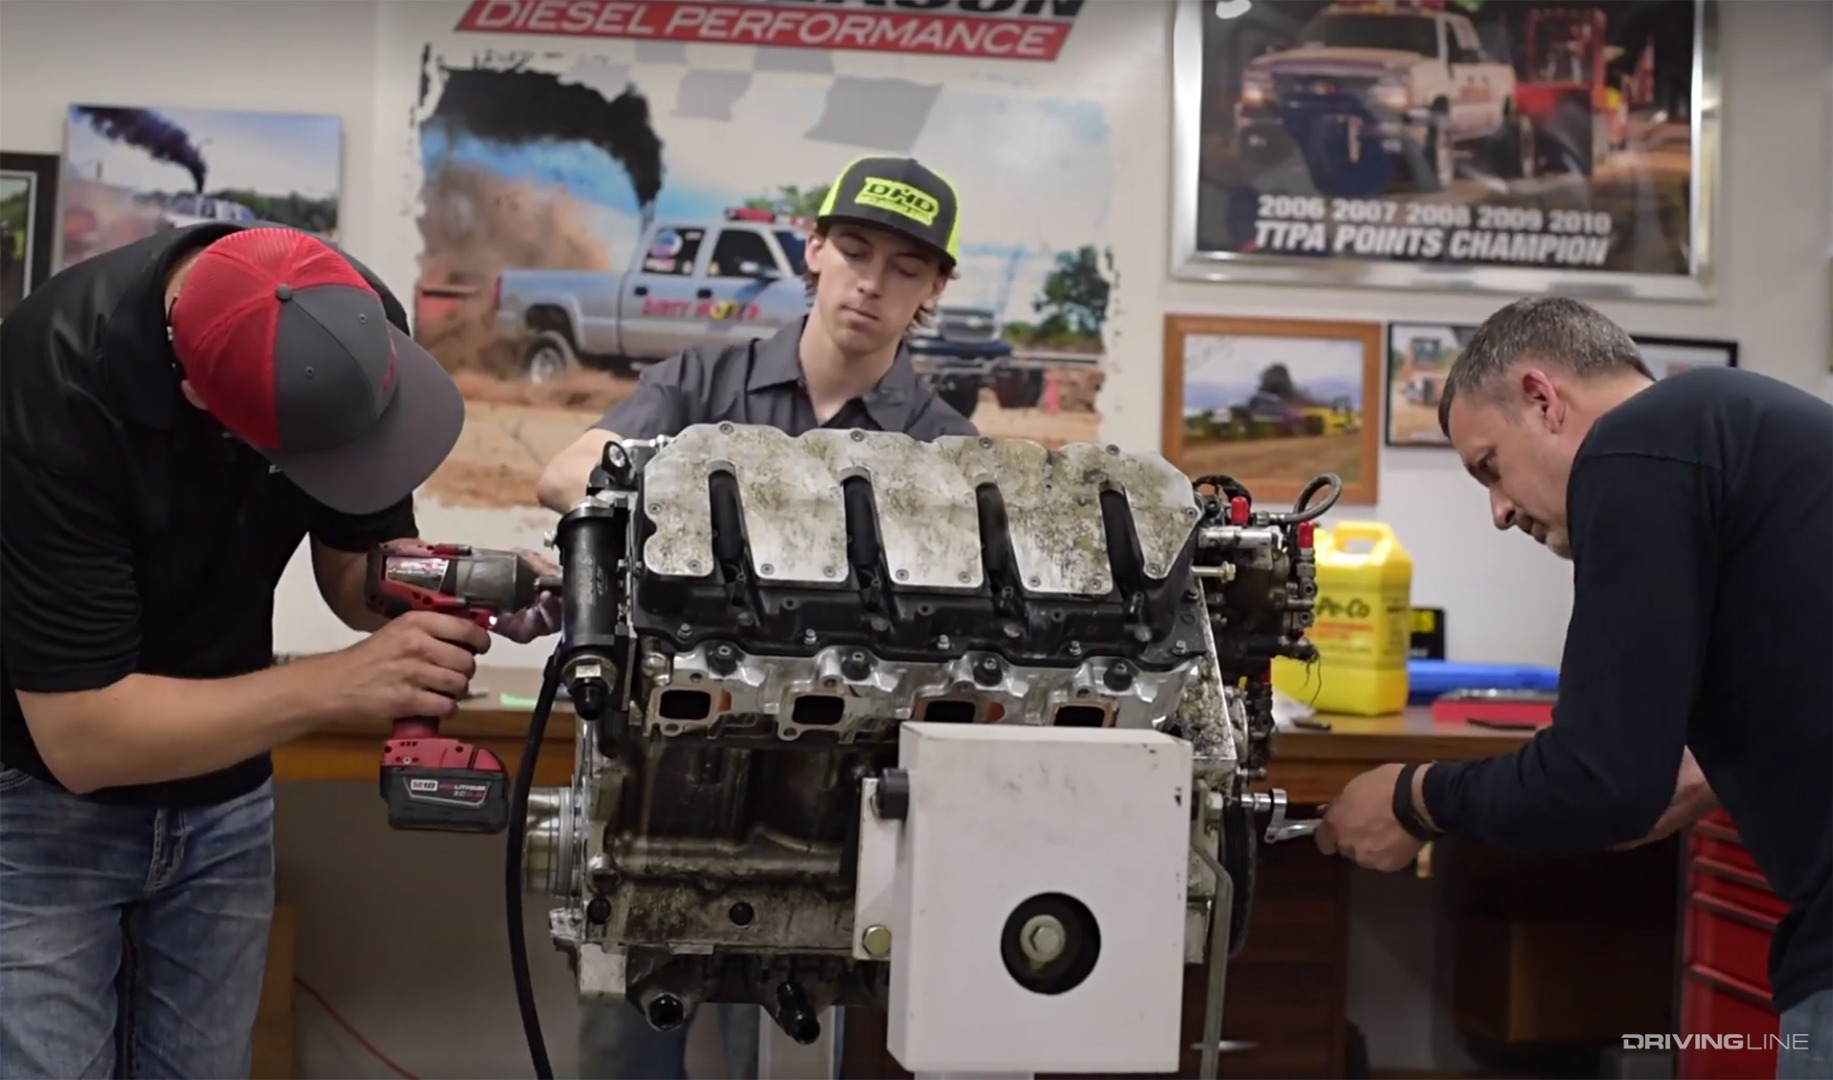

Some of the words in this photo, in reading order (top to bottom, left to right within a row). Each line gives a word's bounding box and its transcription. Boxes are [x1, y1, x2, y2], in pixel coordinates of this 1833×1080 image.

[475, 0, 654, 34] DIESEL
[664, 6, 1055, 56] PERFORMANCE
[866, 183, 935, 213] DHD
[1257, 194, 1326, 220] 2006
[1332, 198, 1397, 223] 2007
[1405, 203, 1472, 228] 2008
[1477, 206, 1543, 231] 2009
[1549, 210, 1612, 235] 2010
[1254, 219, 1326, 251] TTPA
[1333, 224, 1446, 257] POINTS
[1450, 230, 1610, 266] CHAMPION
